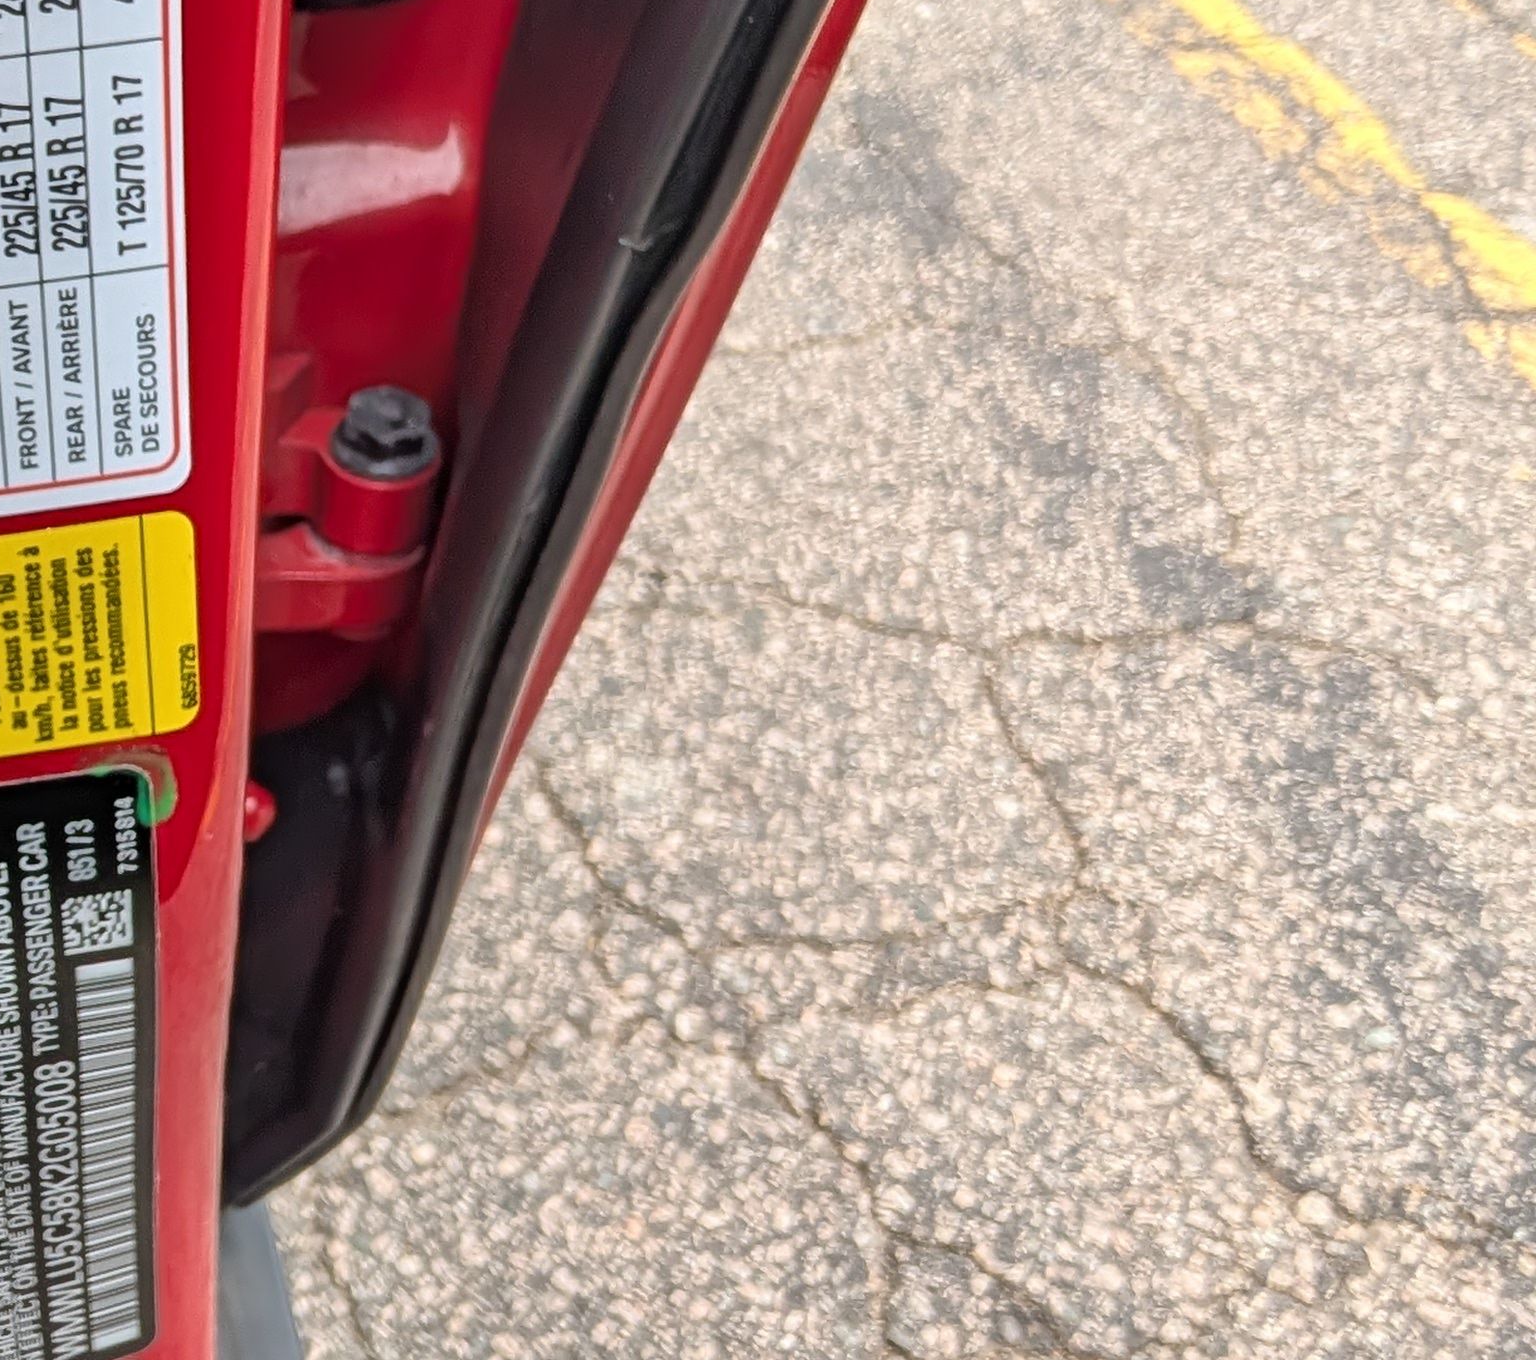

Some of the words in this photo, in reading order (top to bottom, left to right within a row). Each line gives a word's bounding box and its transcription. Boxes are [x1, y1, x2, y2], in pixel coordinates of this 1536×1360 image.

[43, 96, 82, 127] 17
[111, 75, 143, 106] 17
[46, 135, 83, 157] R
[113, 114, 144, 136] R
[0, 170, 37, 258] 225/45
[47, 164, 86, 252] 225/45
[114, 143, 146, 231] 125/70
[117, 240, 147, 257] T
[8, 299, 32, 374] AVANT
[56, 287, 82, 384] ARRIÈRE
[14, 381, 34, 390] /
[63, 391, 84, 399] /
[135, 313, 159, 419] SECOURS
[15, 396, 39, 470] FRONT
[65, 405, 87, 464] REAR
[112, 386, 133, 458] SPARE
[140, 422, 160, 453] DE
[15, 821, 49, 872] CAR
[20, 873, 57, 1001] PASSENGER
[30, 1000, 60, 1057] TYPE:
